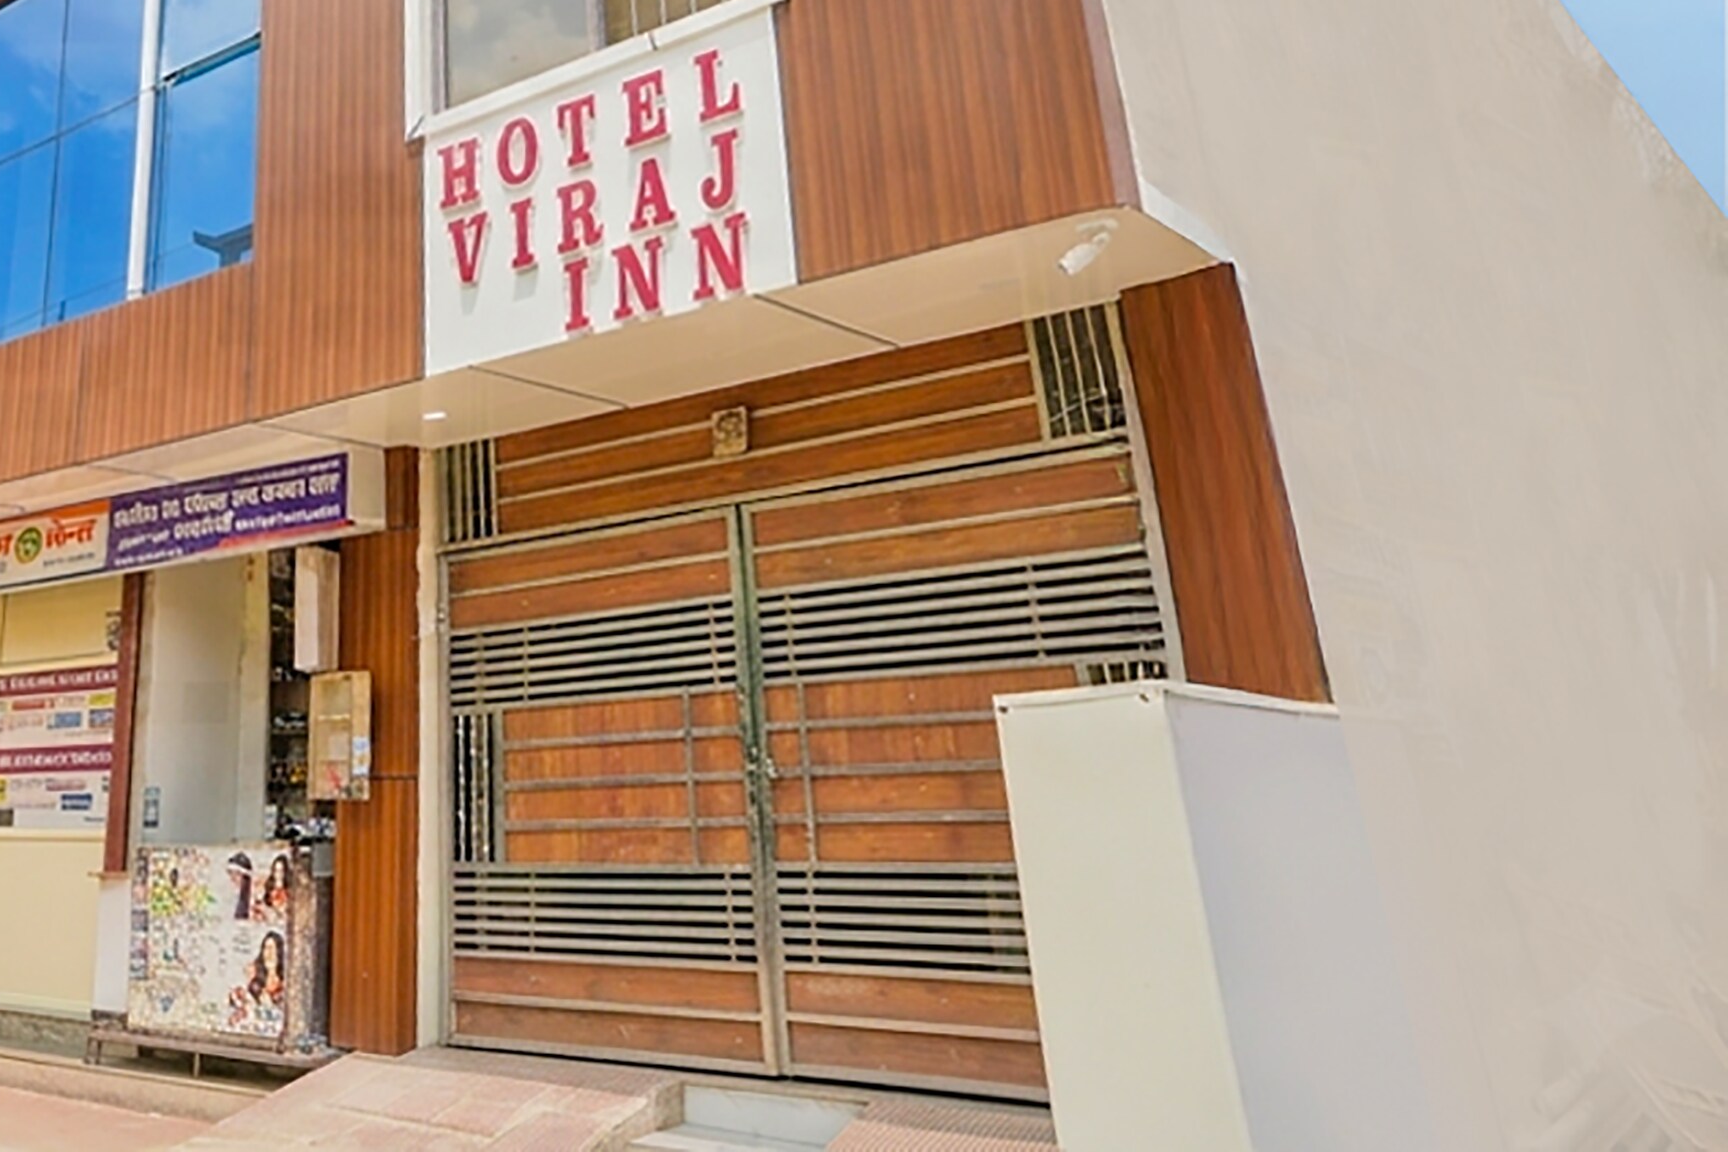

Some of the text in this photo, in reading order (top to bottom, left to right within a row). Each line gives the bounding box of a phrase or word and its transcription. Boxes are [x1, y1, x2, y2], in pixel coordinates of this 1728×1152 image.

[436, 48, 742, 209] HOTEL
[447, 128, 739, 283] VIRAJ
[562, 211, 747, 332] INN
